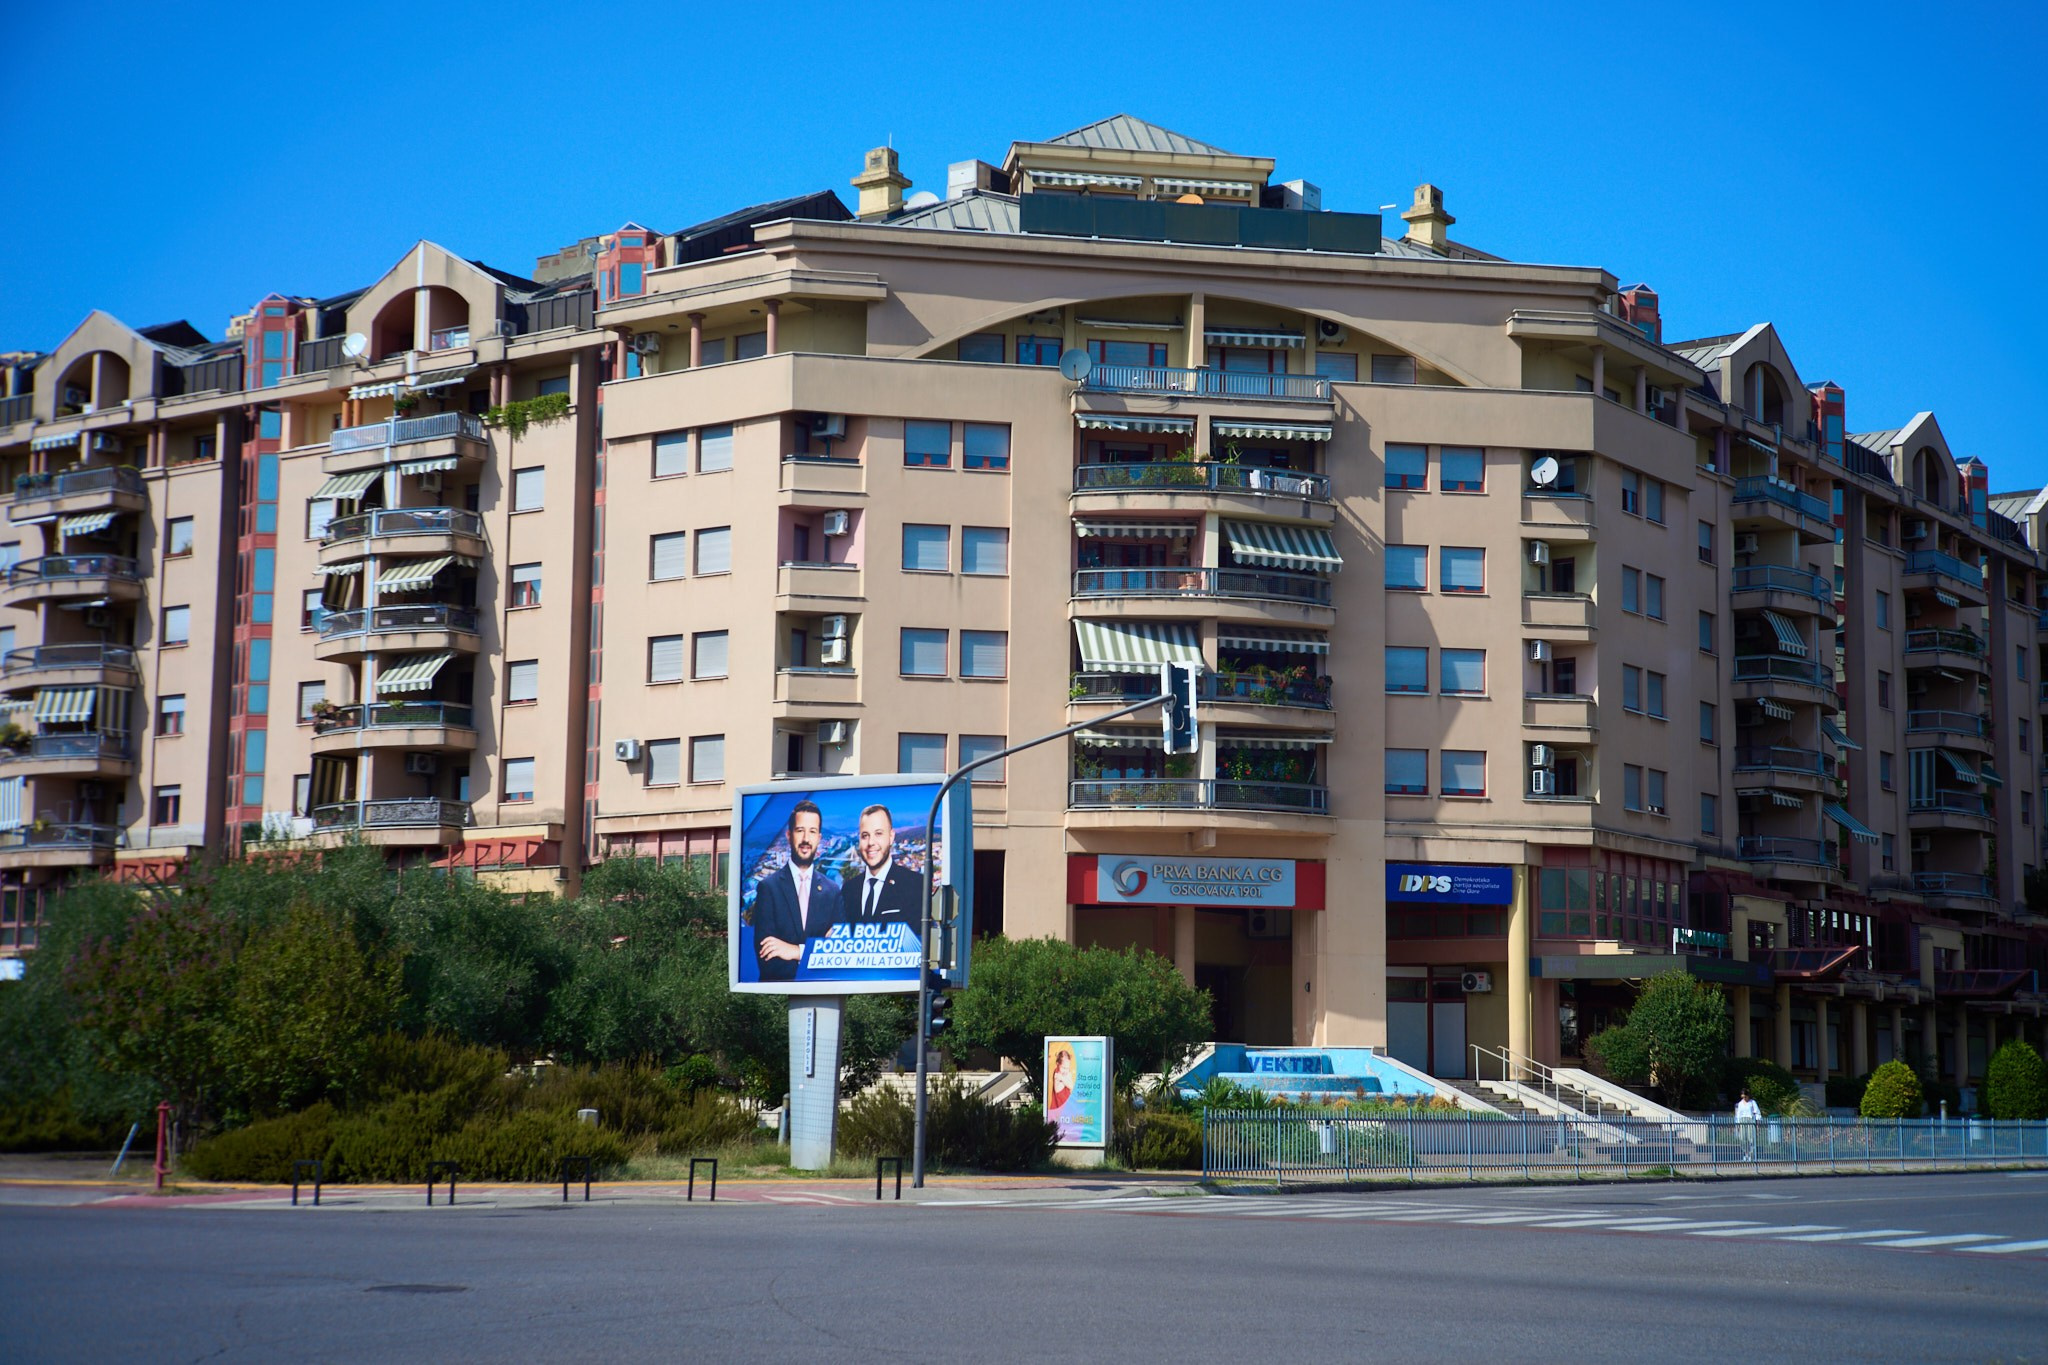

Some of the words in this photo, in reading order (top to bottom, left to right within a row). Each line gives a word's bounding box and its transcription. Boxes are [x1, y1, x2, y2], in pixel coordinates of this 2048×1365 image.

[1153, 864, 1192, 879] PRVA
[1197, 866, 1254, 881] BANKA
[1258, 868, 1282, 881] CG
[1399, 874, 1452, 893] DPS
[1170, 884, 1236, 897] OSNOVANA
[1240, 886, 1263, 898] 1901.
[831, 924, 851, 938] ZA
[853, 924, 901, 938] BOLJU
[811, 956, 851, 966] JAKOV
[1093, 1082, 1101, 1090] od
[1060, 1115, 1070, 1124] na
